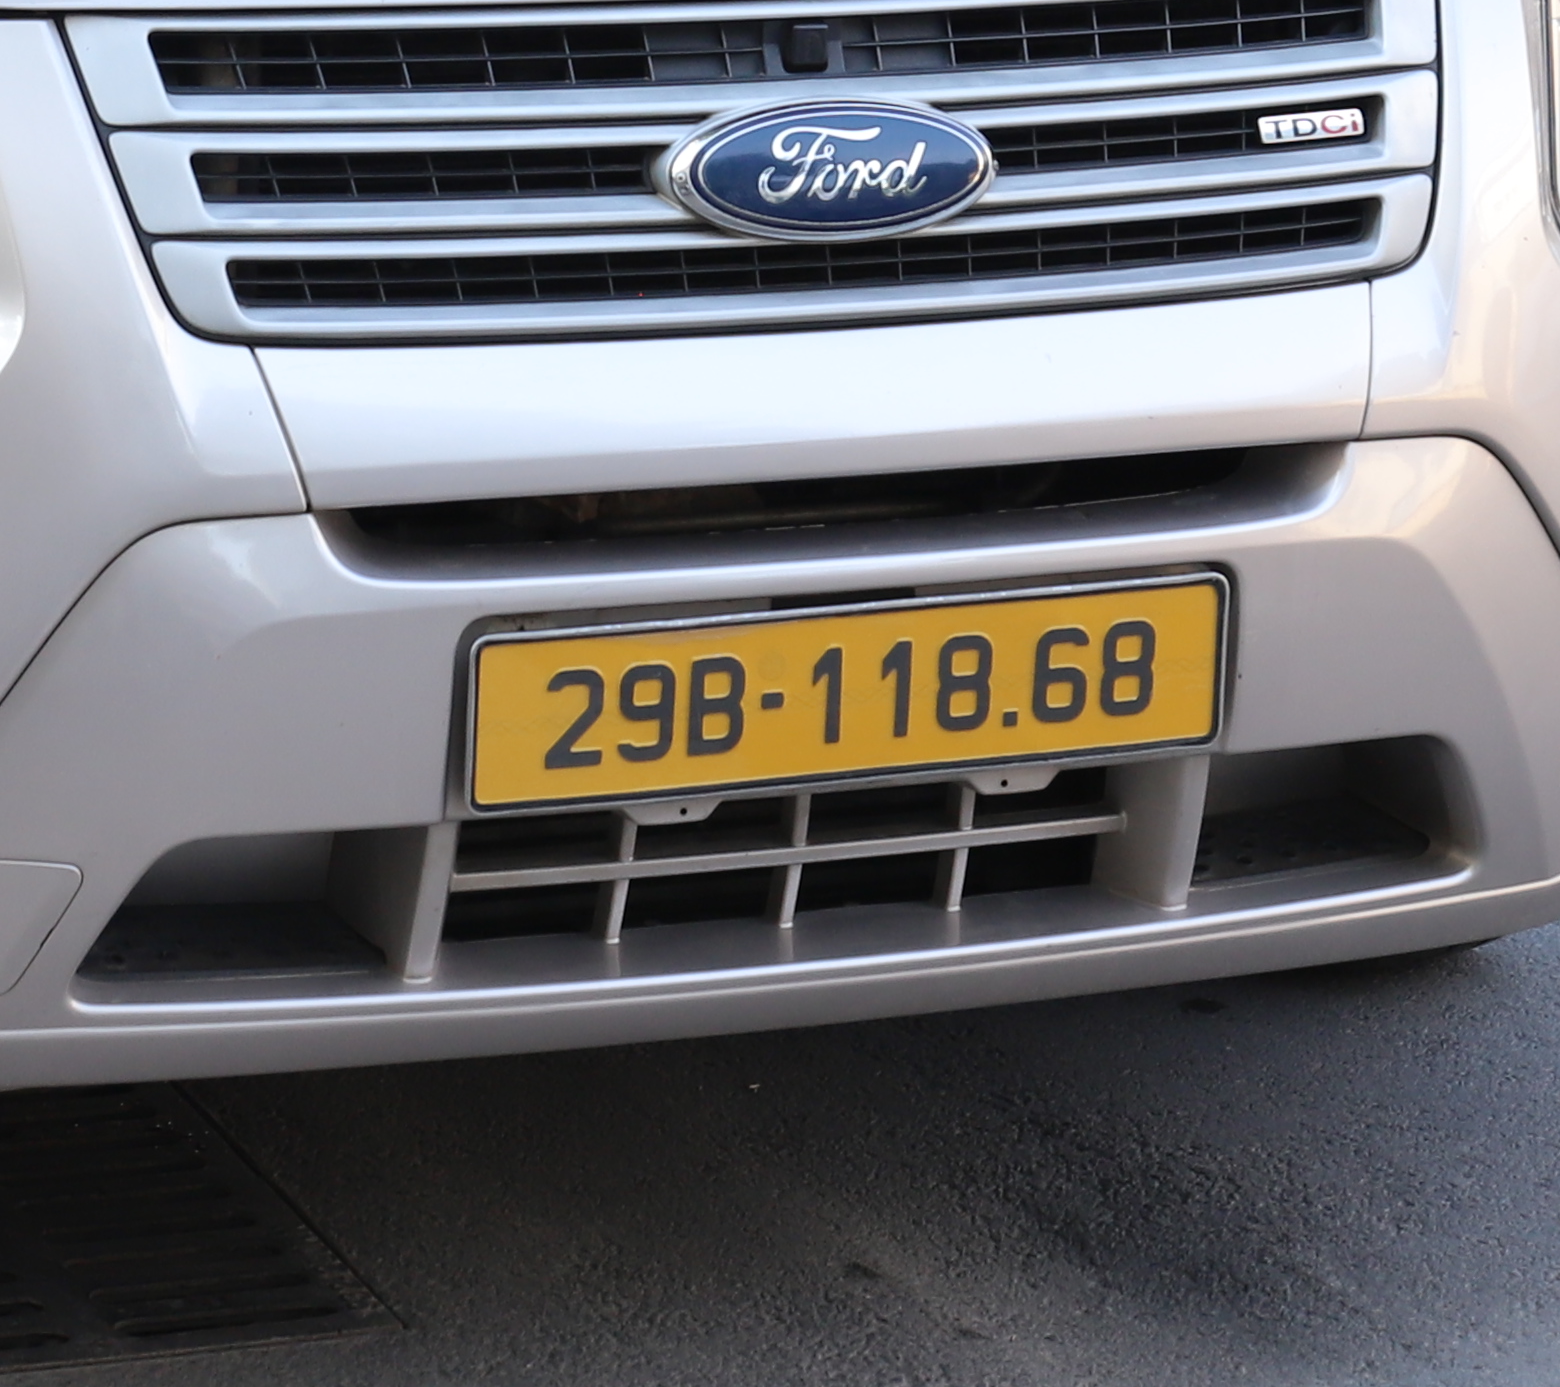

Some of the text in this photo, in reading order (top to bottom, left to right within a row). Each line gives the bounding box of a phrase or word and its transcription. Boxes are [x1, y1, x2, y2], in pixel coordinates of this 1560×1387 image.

[758, 125, 928, 204] Ford
[1264, 113, 1360, 140] TDCi
[543, 618, 1158, 771] 29B-118.68
